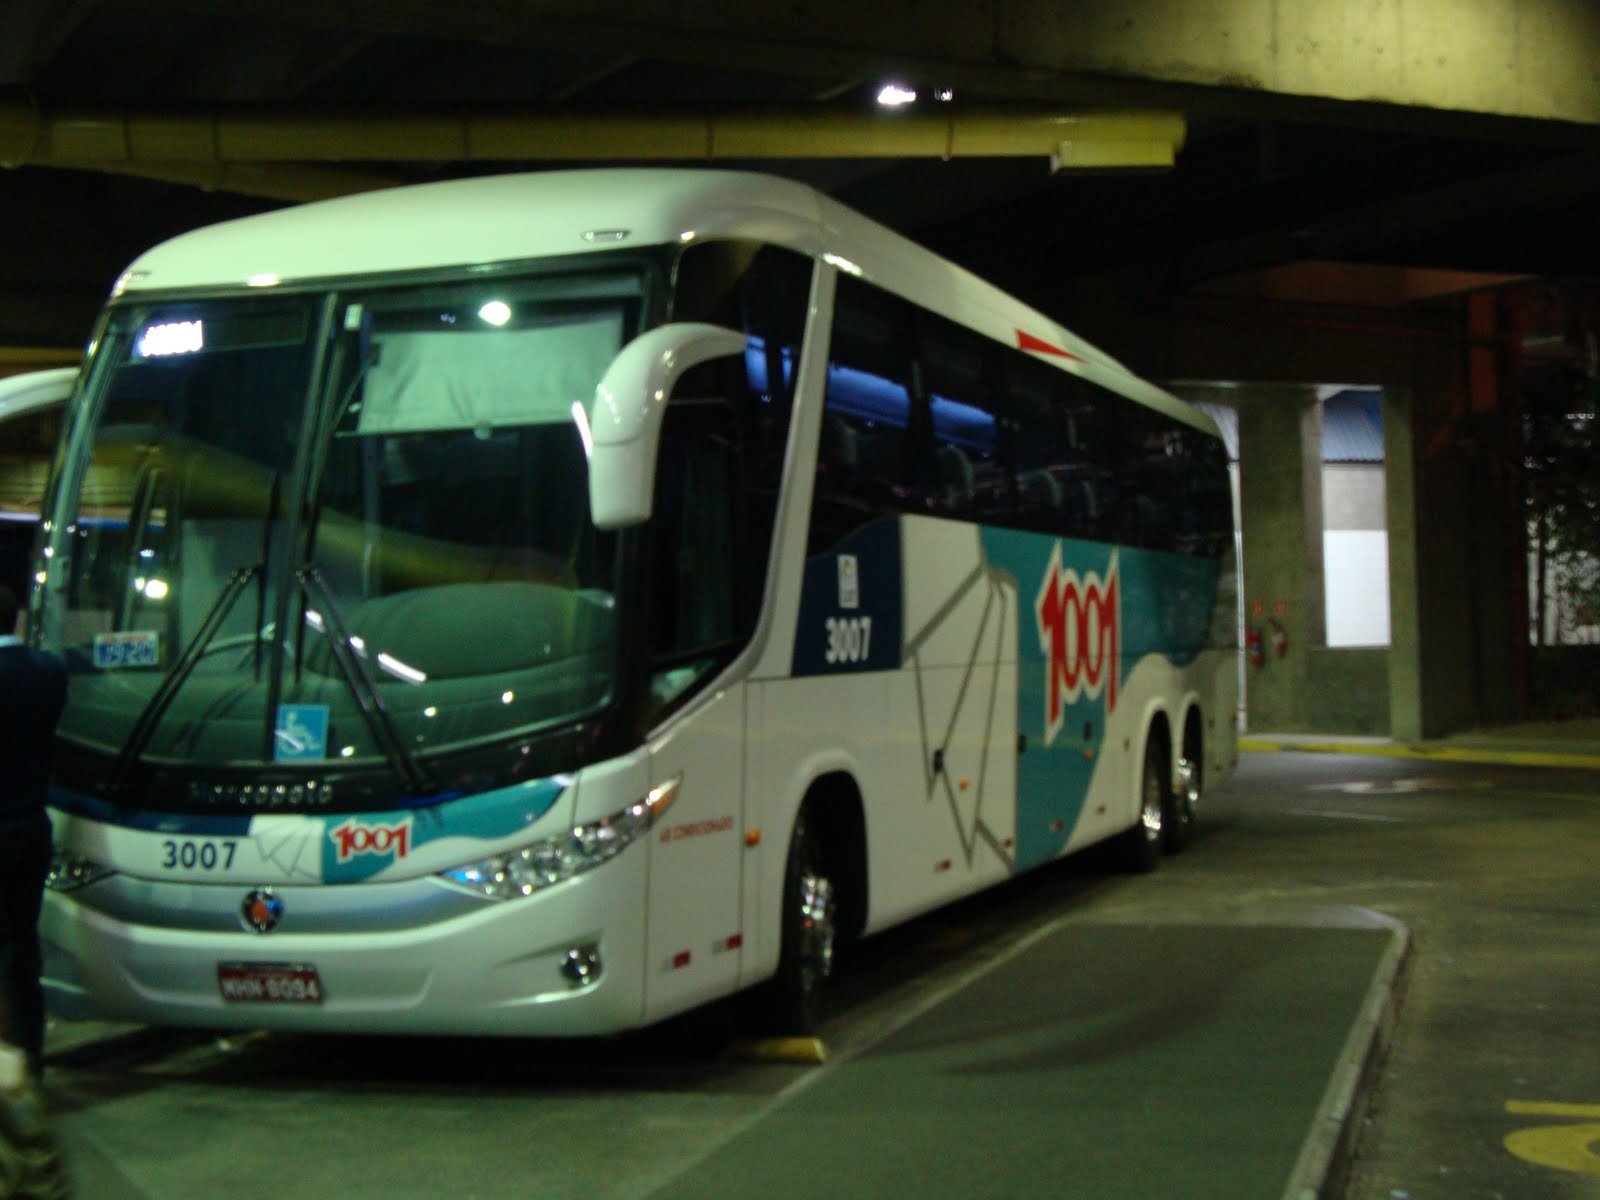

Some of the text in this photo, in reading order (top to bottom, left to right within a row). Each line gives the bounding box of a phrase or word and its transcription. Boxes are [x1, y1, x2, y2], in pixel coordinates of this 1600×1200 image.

[825, 616, 872, 664] 3007
[1036, 543, 1121, 741] 1001
[162, 840, 238, 869] 3007
[330, 817, 413, 864] 1001
